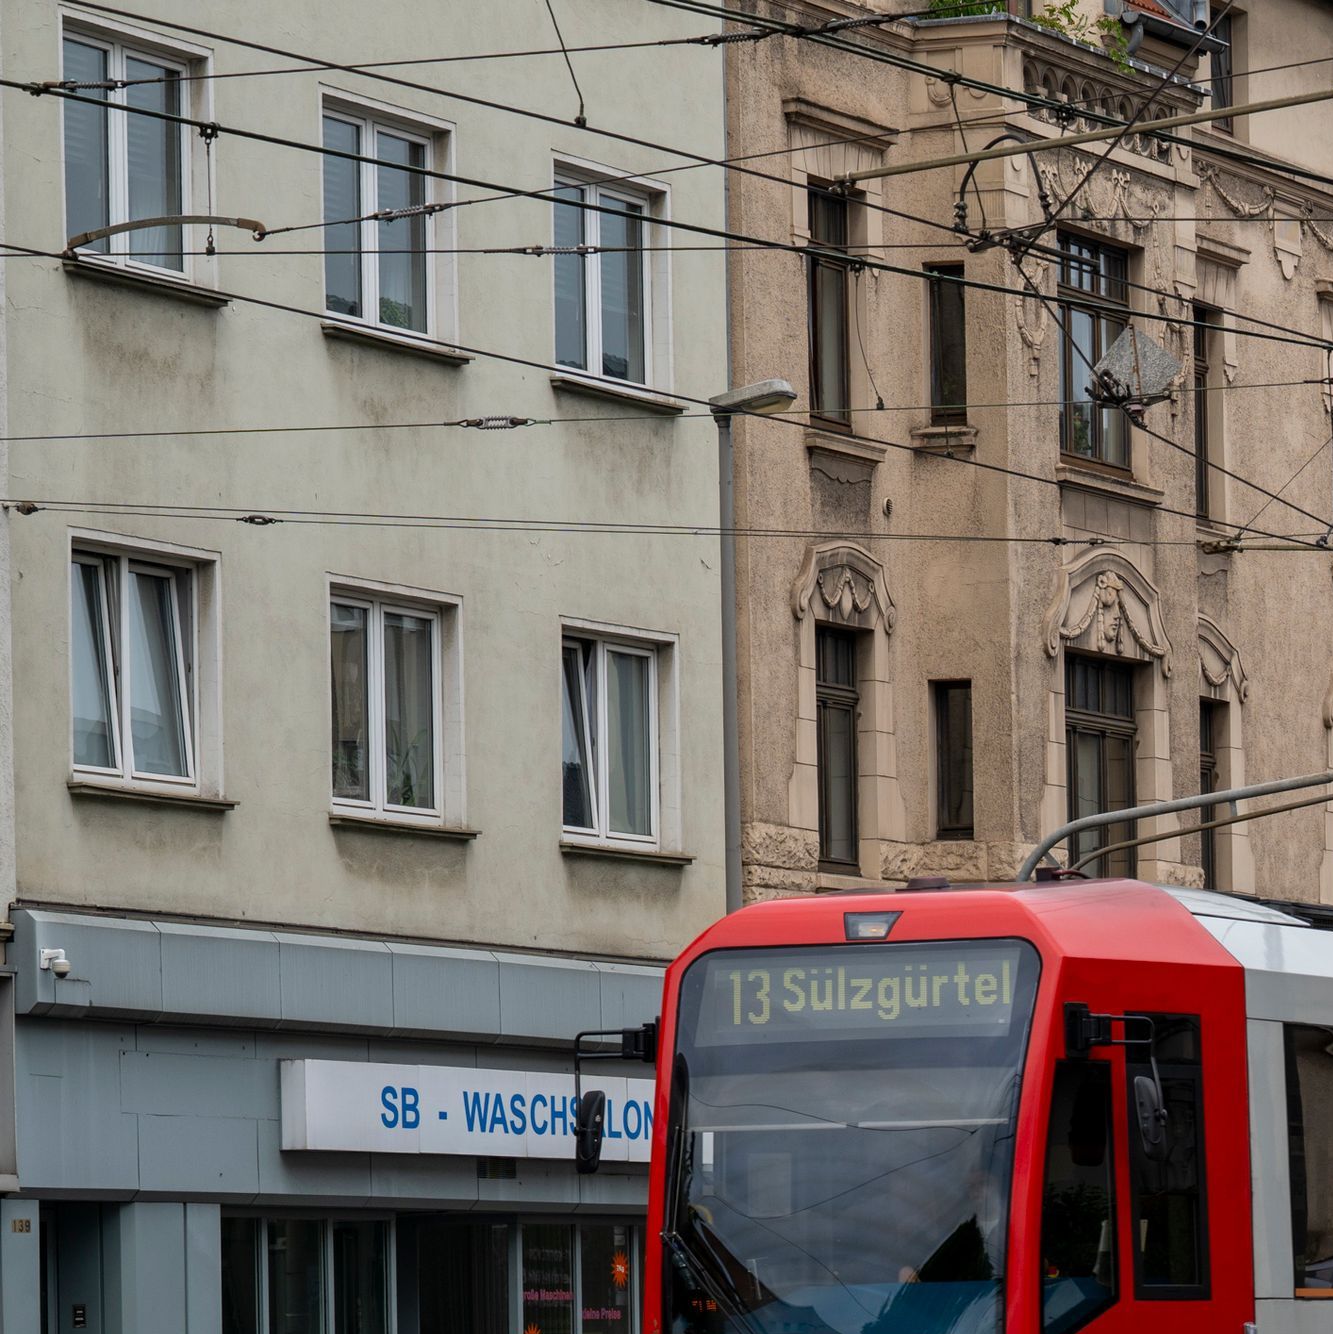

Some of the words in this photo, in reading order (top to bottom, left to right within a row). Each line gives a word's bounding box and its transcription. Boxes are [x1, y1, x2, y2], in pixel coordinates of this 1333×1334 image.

[729, 969, 771, 1025] 13
[783, 960, 1011, 1020] Sülzgürtel
[380, 1085, 420, 1129] SB
[462, 1091, 654, 1140] WASCHSLON
[13, 1220, 31, 1233] 139
